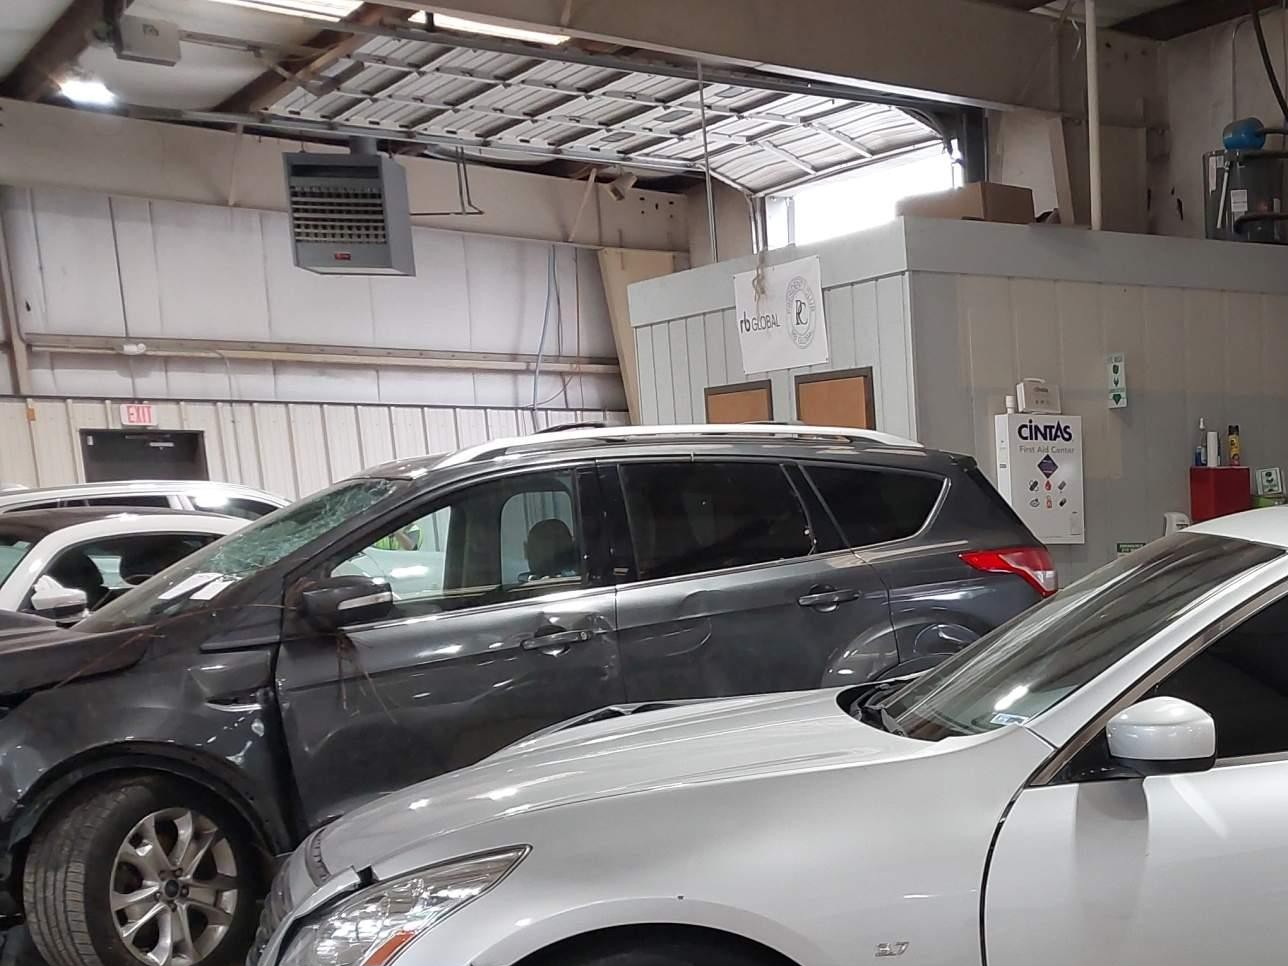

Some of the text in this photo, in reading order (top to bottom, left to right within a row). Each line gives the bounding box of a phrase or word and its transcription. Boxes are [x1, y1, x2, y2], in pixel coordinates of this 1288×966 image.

[751, 313, 781, 332] GLOBAL
[127, 405, 152, 424] EXIT
[1019, 445, 1075, 455] First Aid Center
